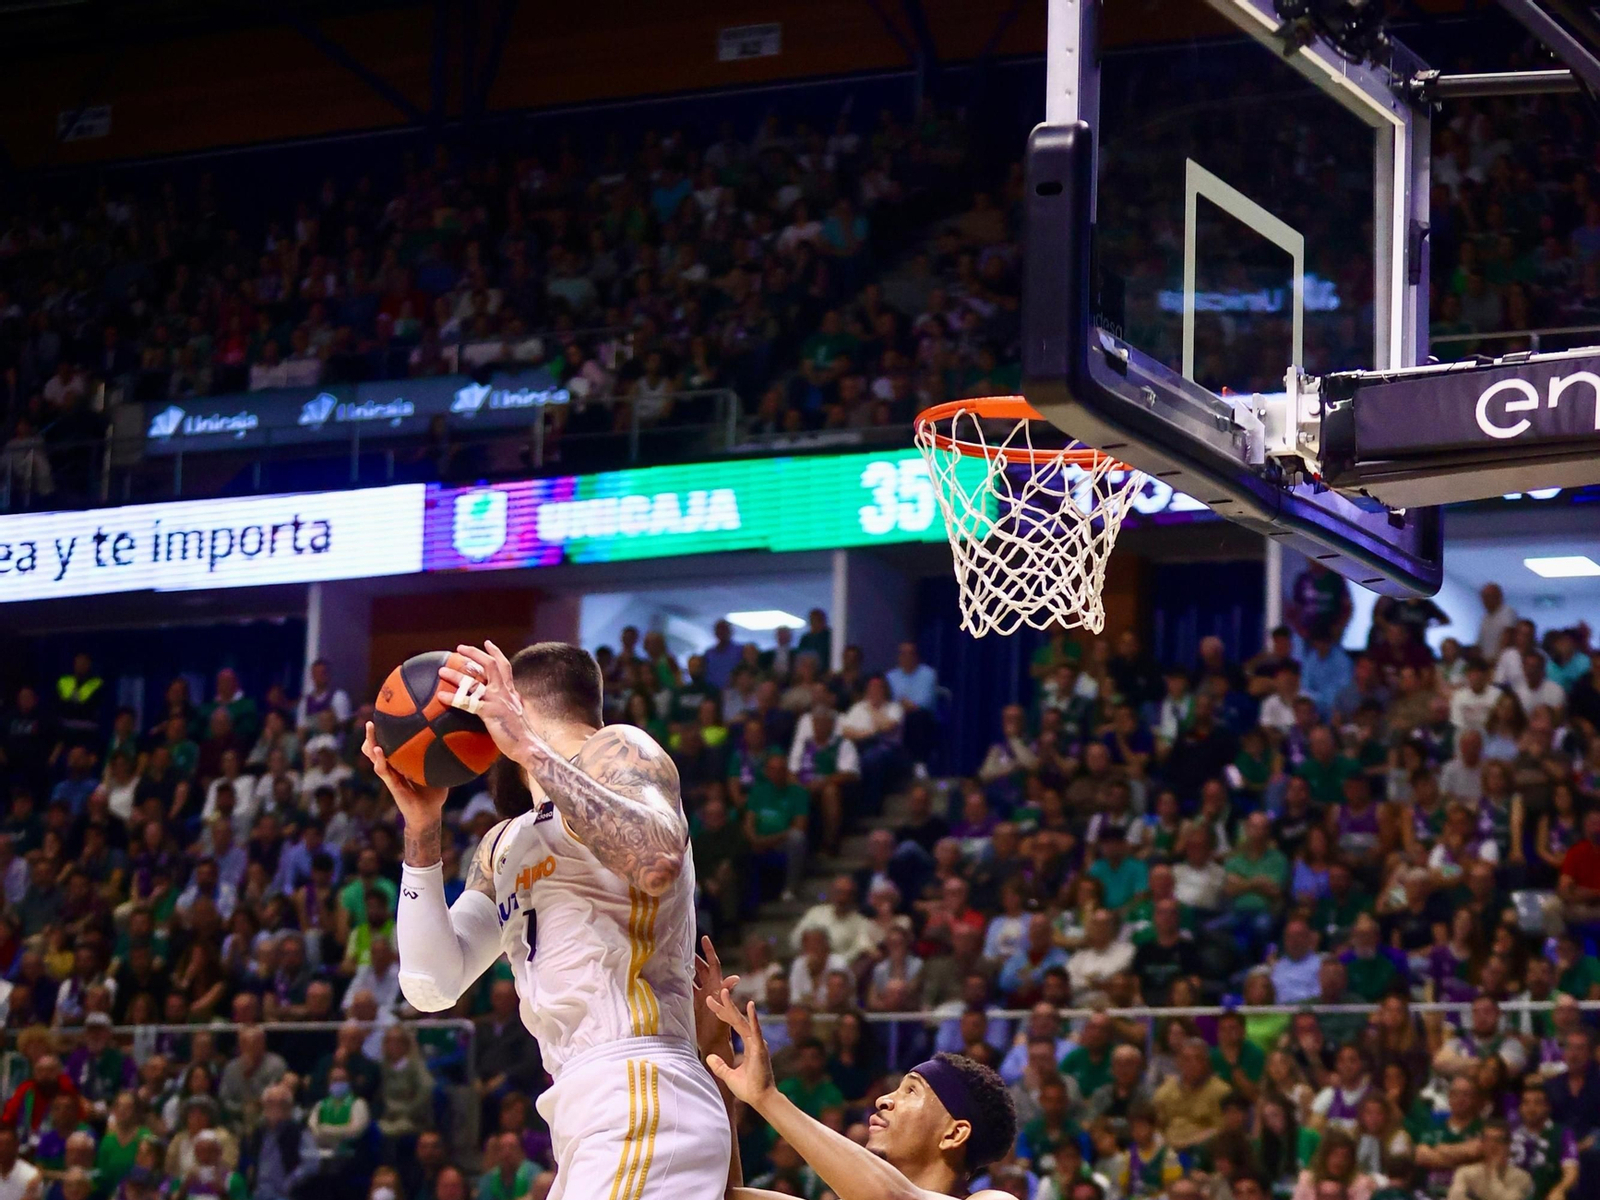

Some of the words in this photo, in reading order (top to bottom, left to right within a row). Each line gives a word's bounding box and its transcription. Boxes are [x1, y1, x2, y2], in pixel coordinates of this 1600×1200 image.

[1475, 371, 1600, 439] en
[536, 487, 742, 541] UNICAJA
[858, 457, 937, 535] 35
[54, 536, 77, 582] y
[93, 526, 136, 568] te
[153, 513, 332, 573] importa
